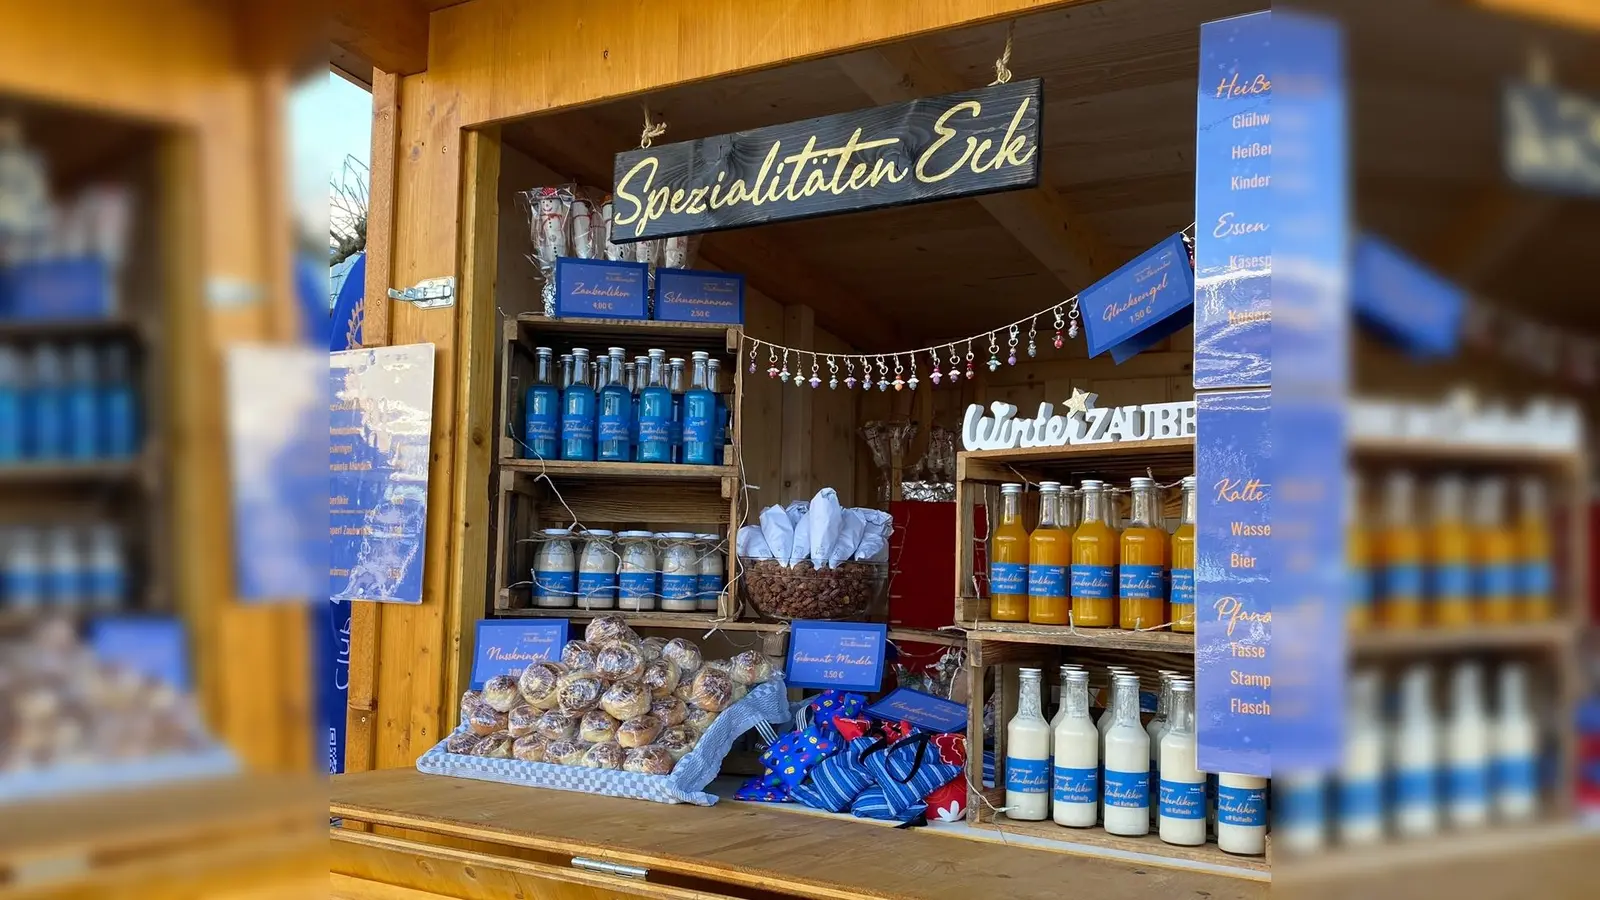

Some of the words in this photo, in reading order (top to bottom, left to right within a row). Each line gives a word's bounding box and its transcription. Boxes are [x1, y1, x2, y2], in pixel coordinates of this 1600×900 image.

[1216, 73, 1271, 99] Heiße
[613, 127, 910, 238] Spezialitäten
[915, 97, 1037, 183] Eck
[1231, 175, 1271, 191] Kinder
[1213, 211, 1270, 239] Essen
[1214, 478, 1271, 502] Kalte
[1231, 521, 1271, 536] Wasse
[1231, 553, 1257, 568] Bier
[1230, 642, 1265, 658] Tasse
[1231, 670, 1271, 689] Stamp
[1231, 698, 1270, 716] Flasch
